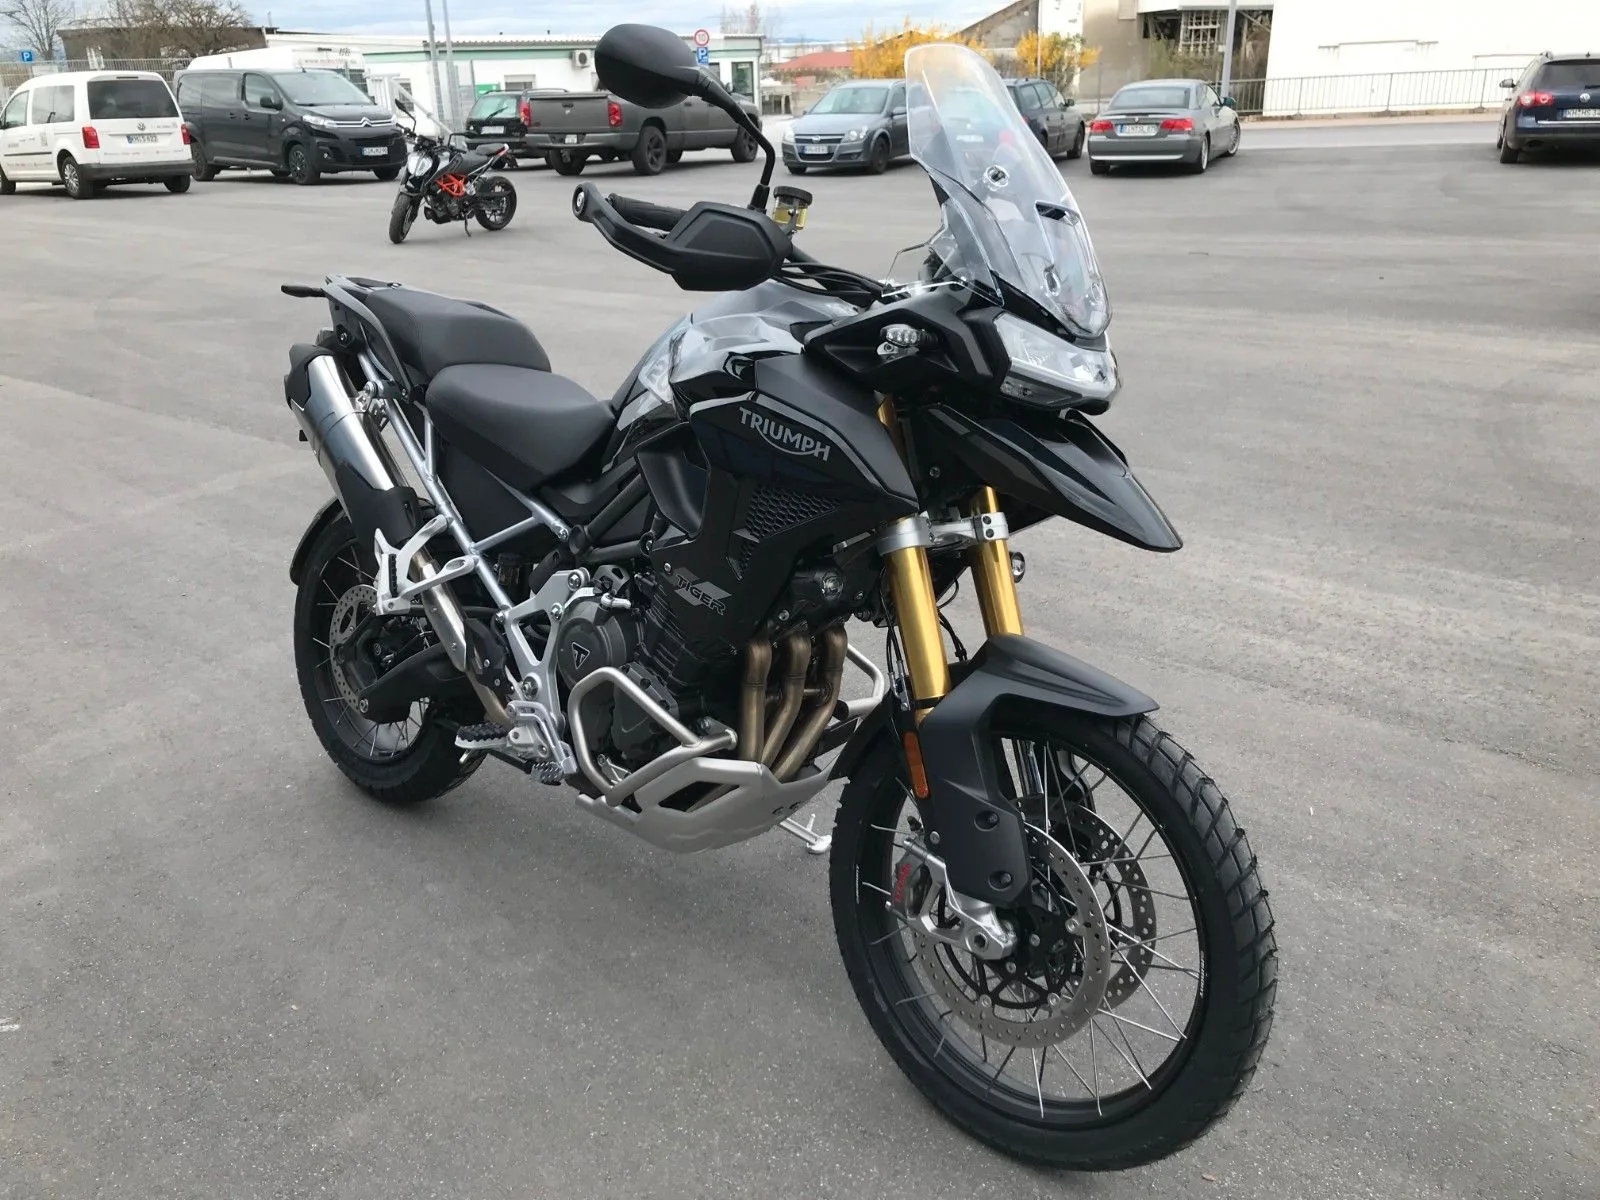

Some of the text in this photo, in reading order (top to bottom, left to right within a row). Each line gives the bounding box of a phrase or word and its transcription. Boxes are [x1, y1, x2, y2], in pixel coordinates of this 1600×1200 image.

[23, 51, 30, 62] P
[698, 48, 706, 60] P
[739, 406, 831, 462] TRIUMPH
[675, 573, 727, 616] TIGER
